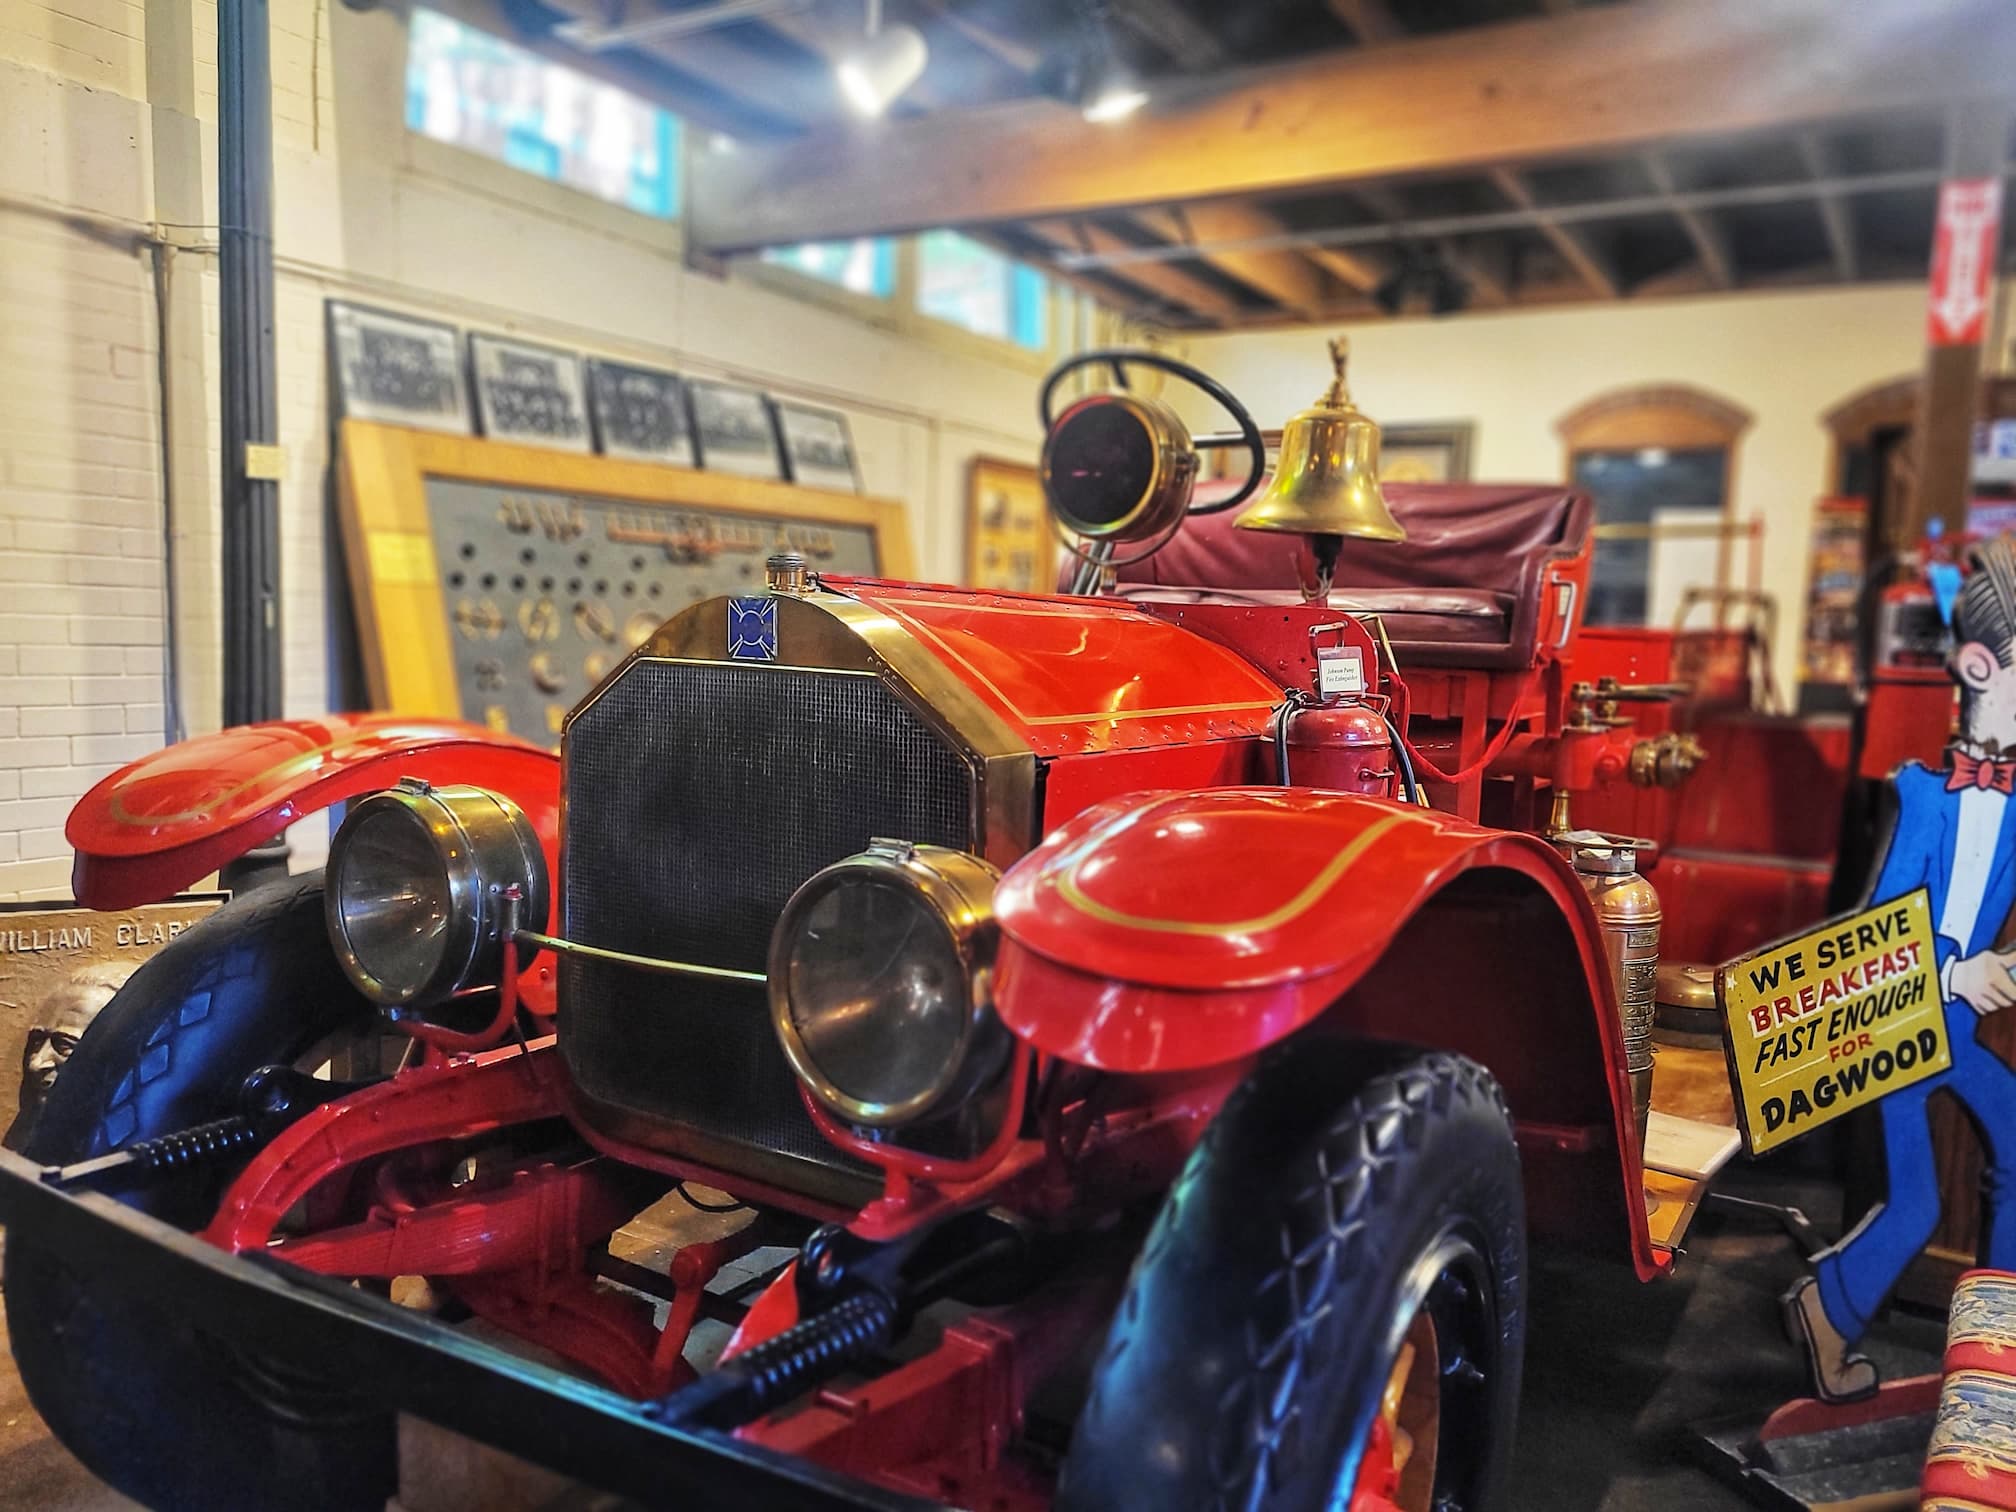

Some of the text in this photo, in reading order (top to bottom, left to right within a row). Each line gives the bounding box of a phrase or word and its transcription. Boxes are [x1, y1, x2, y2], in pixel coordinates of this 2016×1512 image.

[0, 920, 197, 952] ILLIAM CLAR
[1750, 908, 1911, 994] WE SERVE
[1750, 941, 1921, 1036] BREAKFAST
[1754, 973, 1927, 1074] FAST ENOUGH
[1761, 1028, 1938, 1133] DAGWOOD
[1828, 1033, 1874, 1063] FOR
